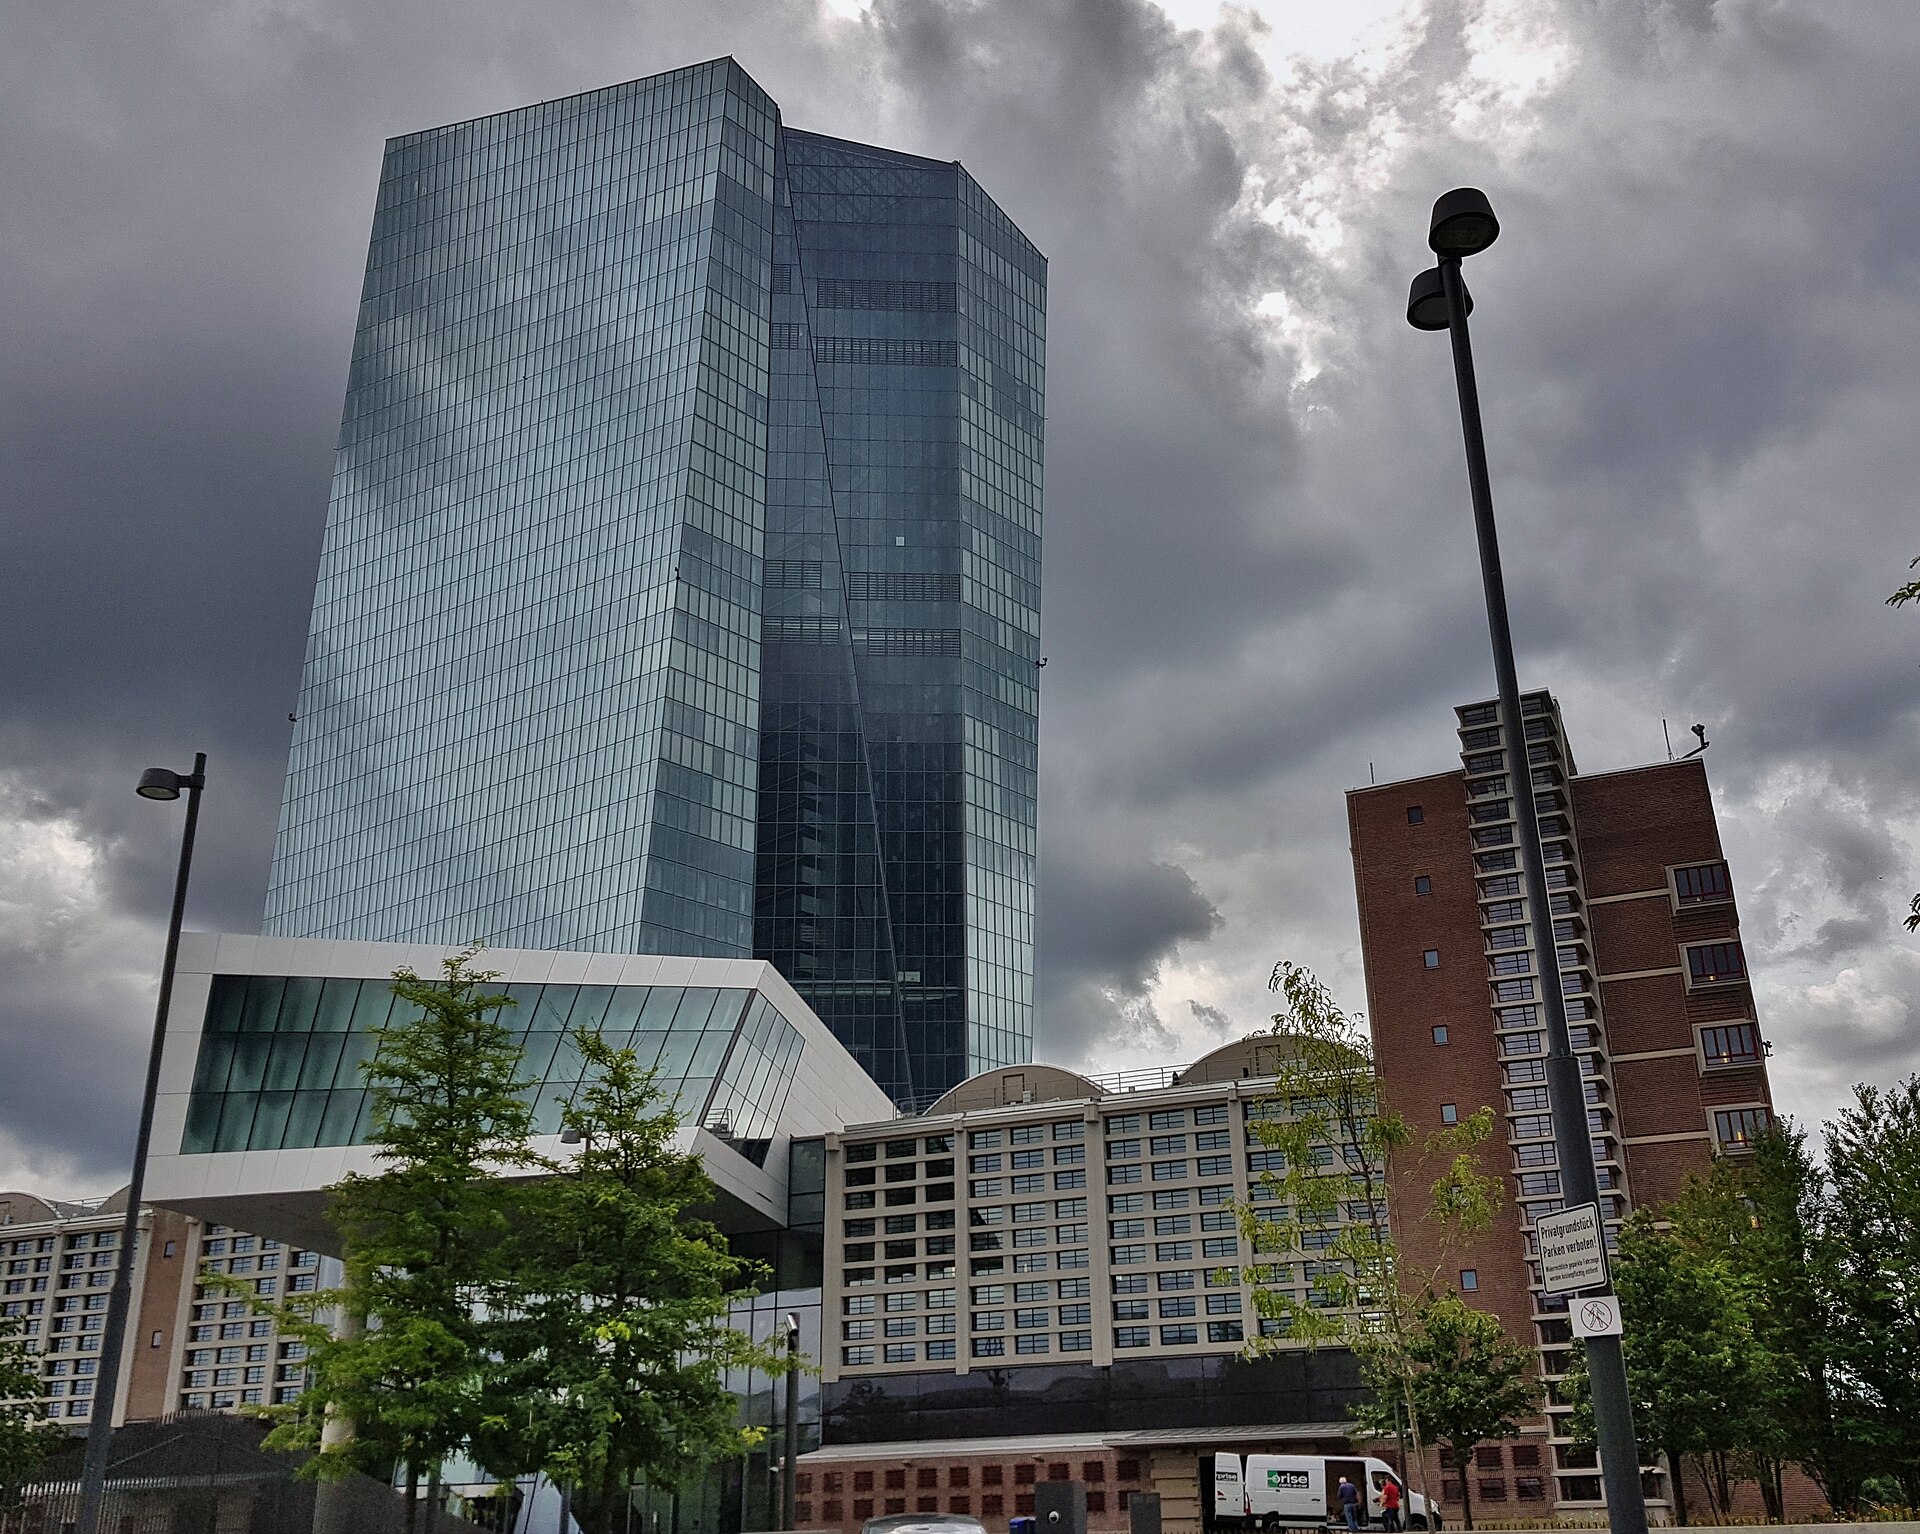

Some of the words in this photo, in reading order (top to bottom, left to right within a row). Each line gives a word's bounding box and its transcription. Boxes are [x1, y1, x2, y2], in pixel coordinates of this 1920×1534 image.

[1541, 1216, 1594, 1239] Privatgrundstück
[1543, 1244, 1565, 1258] Parken
[1566, 1235, 1597, 1253] verboten!
